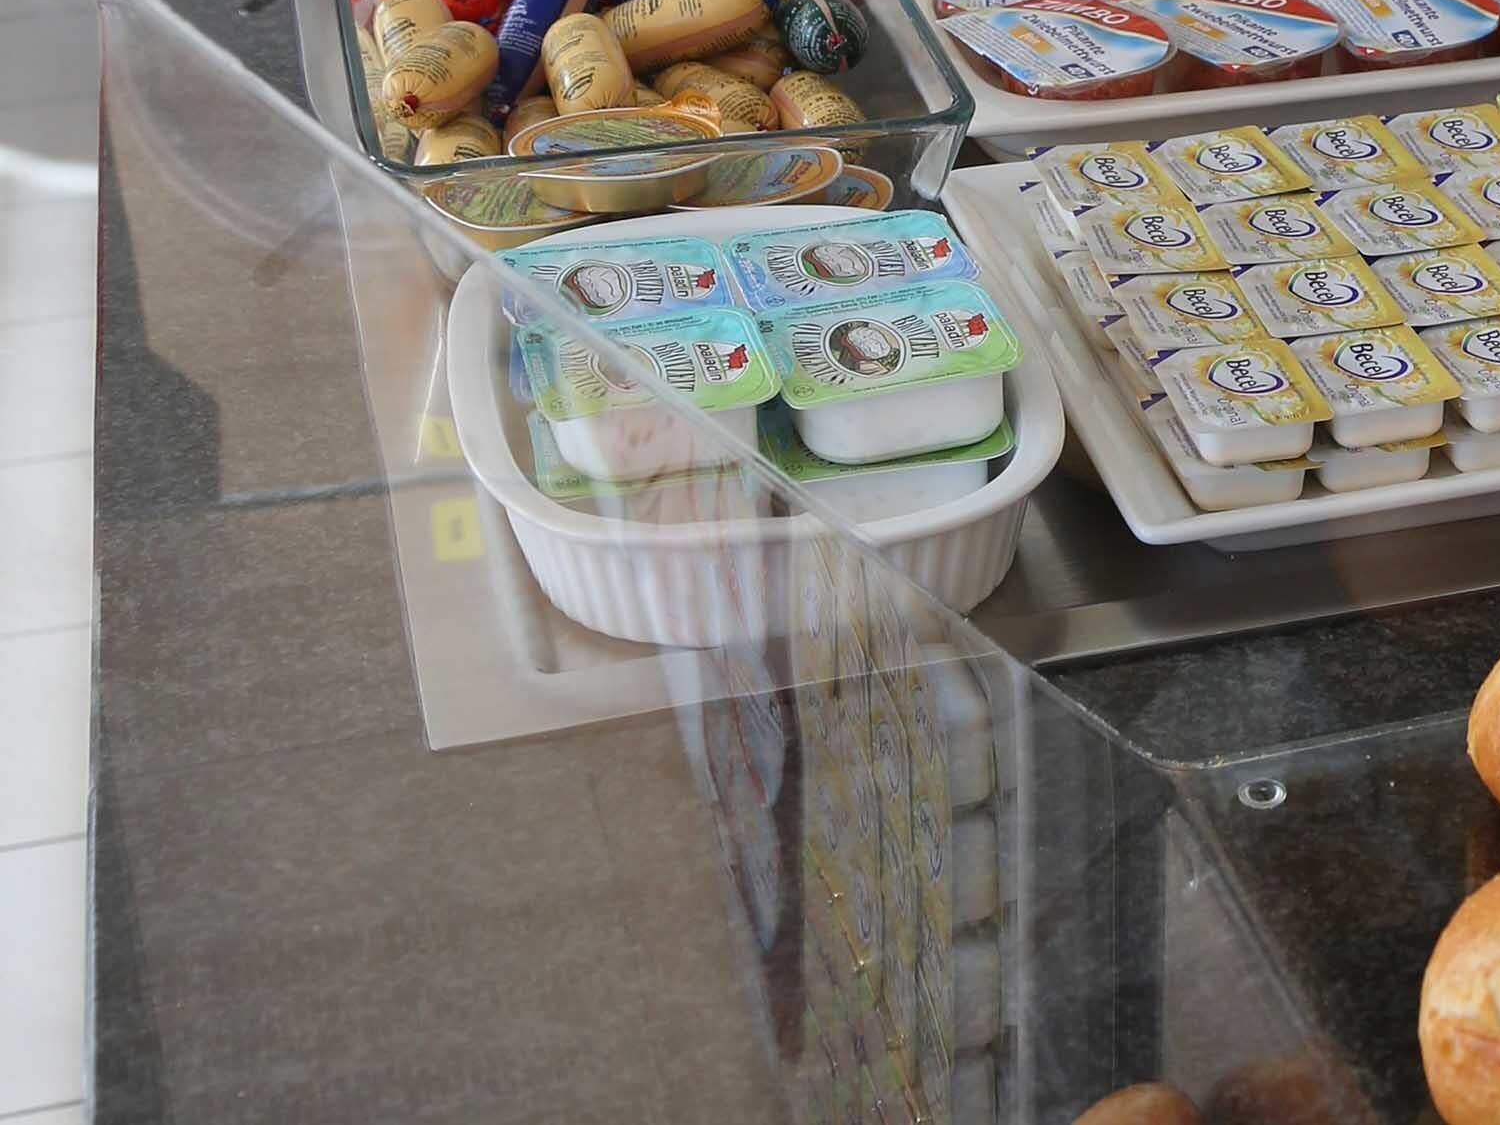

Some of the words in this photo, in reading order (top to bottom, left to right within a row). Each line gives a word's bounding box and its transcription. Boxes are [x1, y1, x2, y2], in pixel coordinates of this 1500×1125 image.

[1024, 0, 1130, 24] ZIMBO
[1228, 13, 1277, 36] Pikante
[1064, 24, 1104, 55] Pikante
[1183, 3, 1299, 55] Zwiebelmettwurst
[1023, 14, 1116, 75] Zwiebelmettwurst
[1327, 131, 1365, 158] Becel
[1442, 119, 1479, 149] Becel
[1094, 157, 1128, 185] Becel
[1208, 143, 1241, 171] Becel
[1265, 209, 1298, 236] Becel
[1382, 195, 1424, 225] Becel
[1142, 215, 1175, 246] Becel
[1305, 270, 1340, 303] Becel
[1426, 265, 1468, 294] Becel
[1183, 289, 1215, 318] Becel
[891, 315, 939, 358] BROTZEIT
[936, 313, 965, 348] paladin
[652, 343, 695, 391] BROTZEIT
[698, 344, 721, 381] paladin
[1227, 359, 1263, 391] Becel
[1350, 344, 1392, 377] Becel
[1218, 398, 1247, 426] Original
